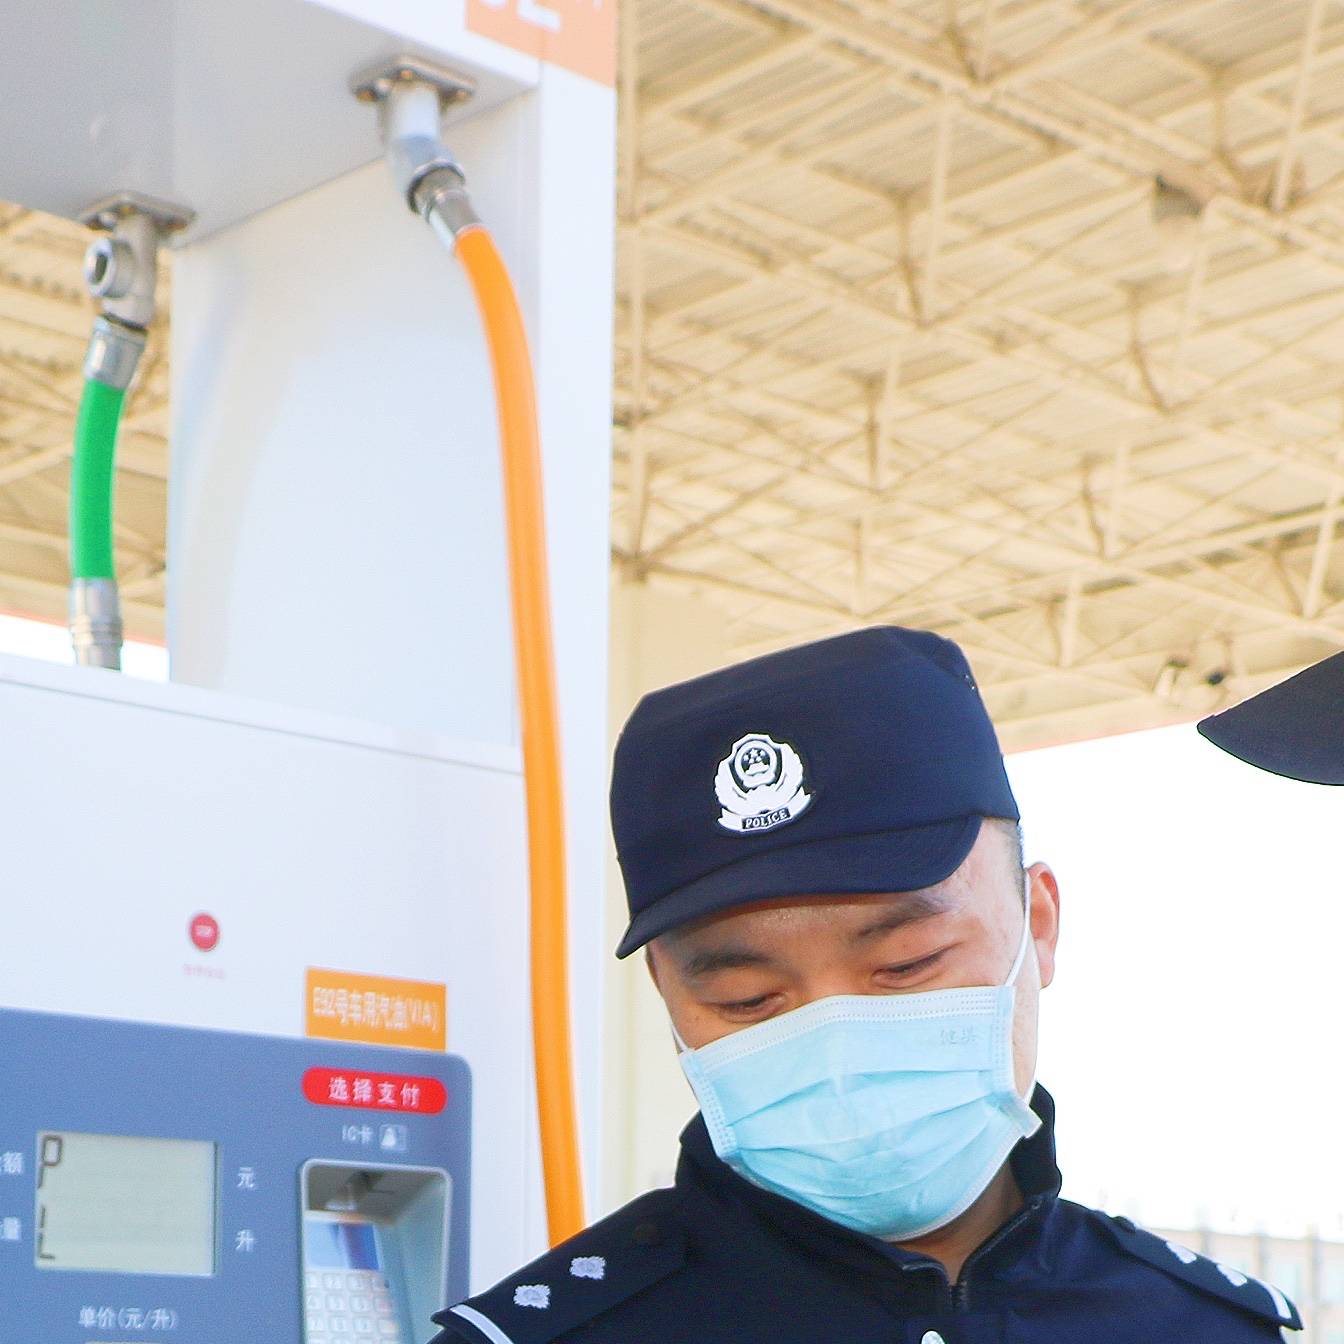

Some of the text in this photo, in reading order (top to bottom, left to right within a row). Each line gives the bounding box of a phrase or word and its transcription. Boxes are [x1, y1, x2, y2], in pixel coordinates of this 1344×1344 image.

[745, 808, 787, 829] POLICE
[329, 1077, 421, 1107] 选择支付
[237, 1166, 255, 1188] 元
[235, 1229, 255, 1251] 升
